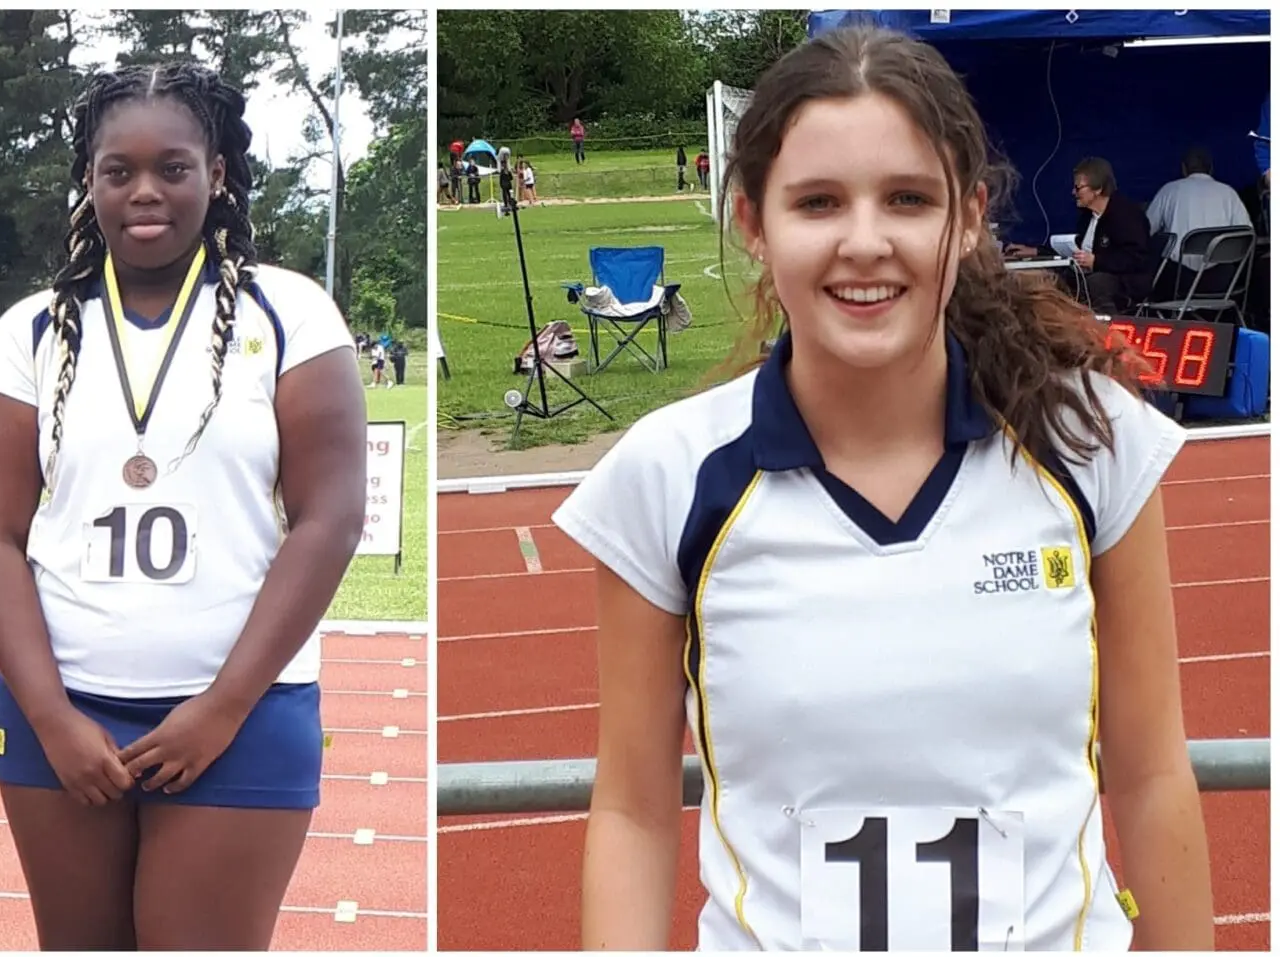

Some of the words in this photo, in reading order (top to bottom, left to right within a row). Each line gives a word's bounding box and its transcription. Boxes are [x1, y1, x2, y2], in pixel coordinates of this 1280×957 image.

[92, 506, 188, 580] 10
[982, 550, 1037, 567] NOTRE
[993, 564, 1039, 580] DAME
[973, 578, 1039, 594] SCHOOL
[825, 816, 979, 952] 11
